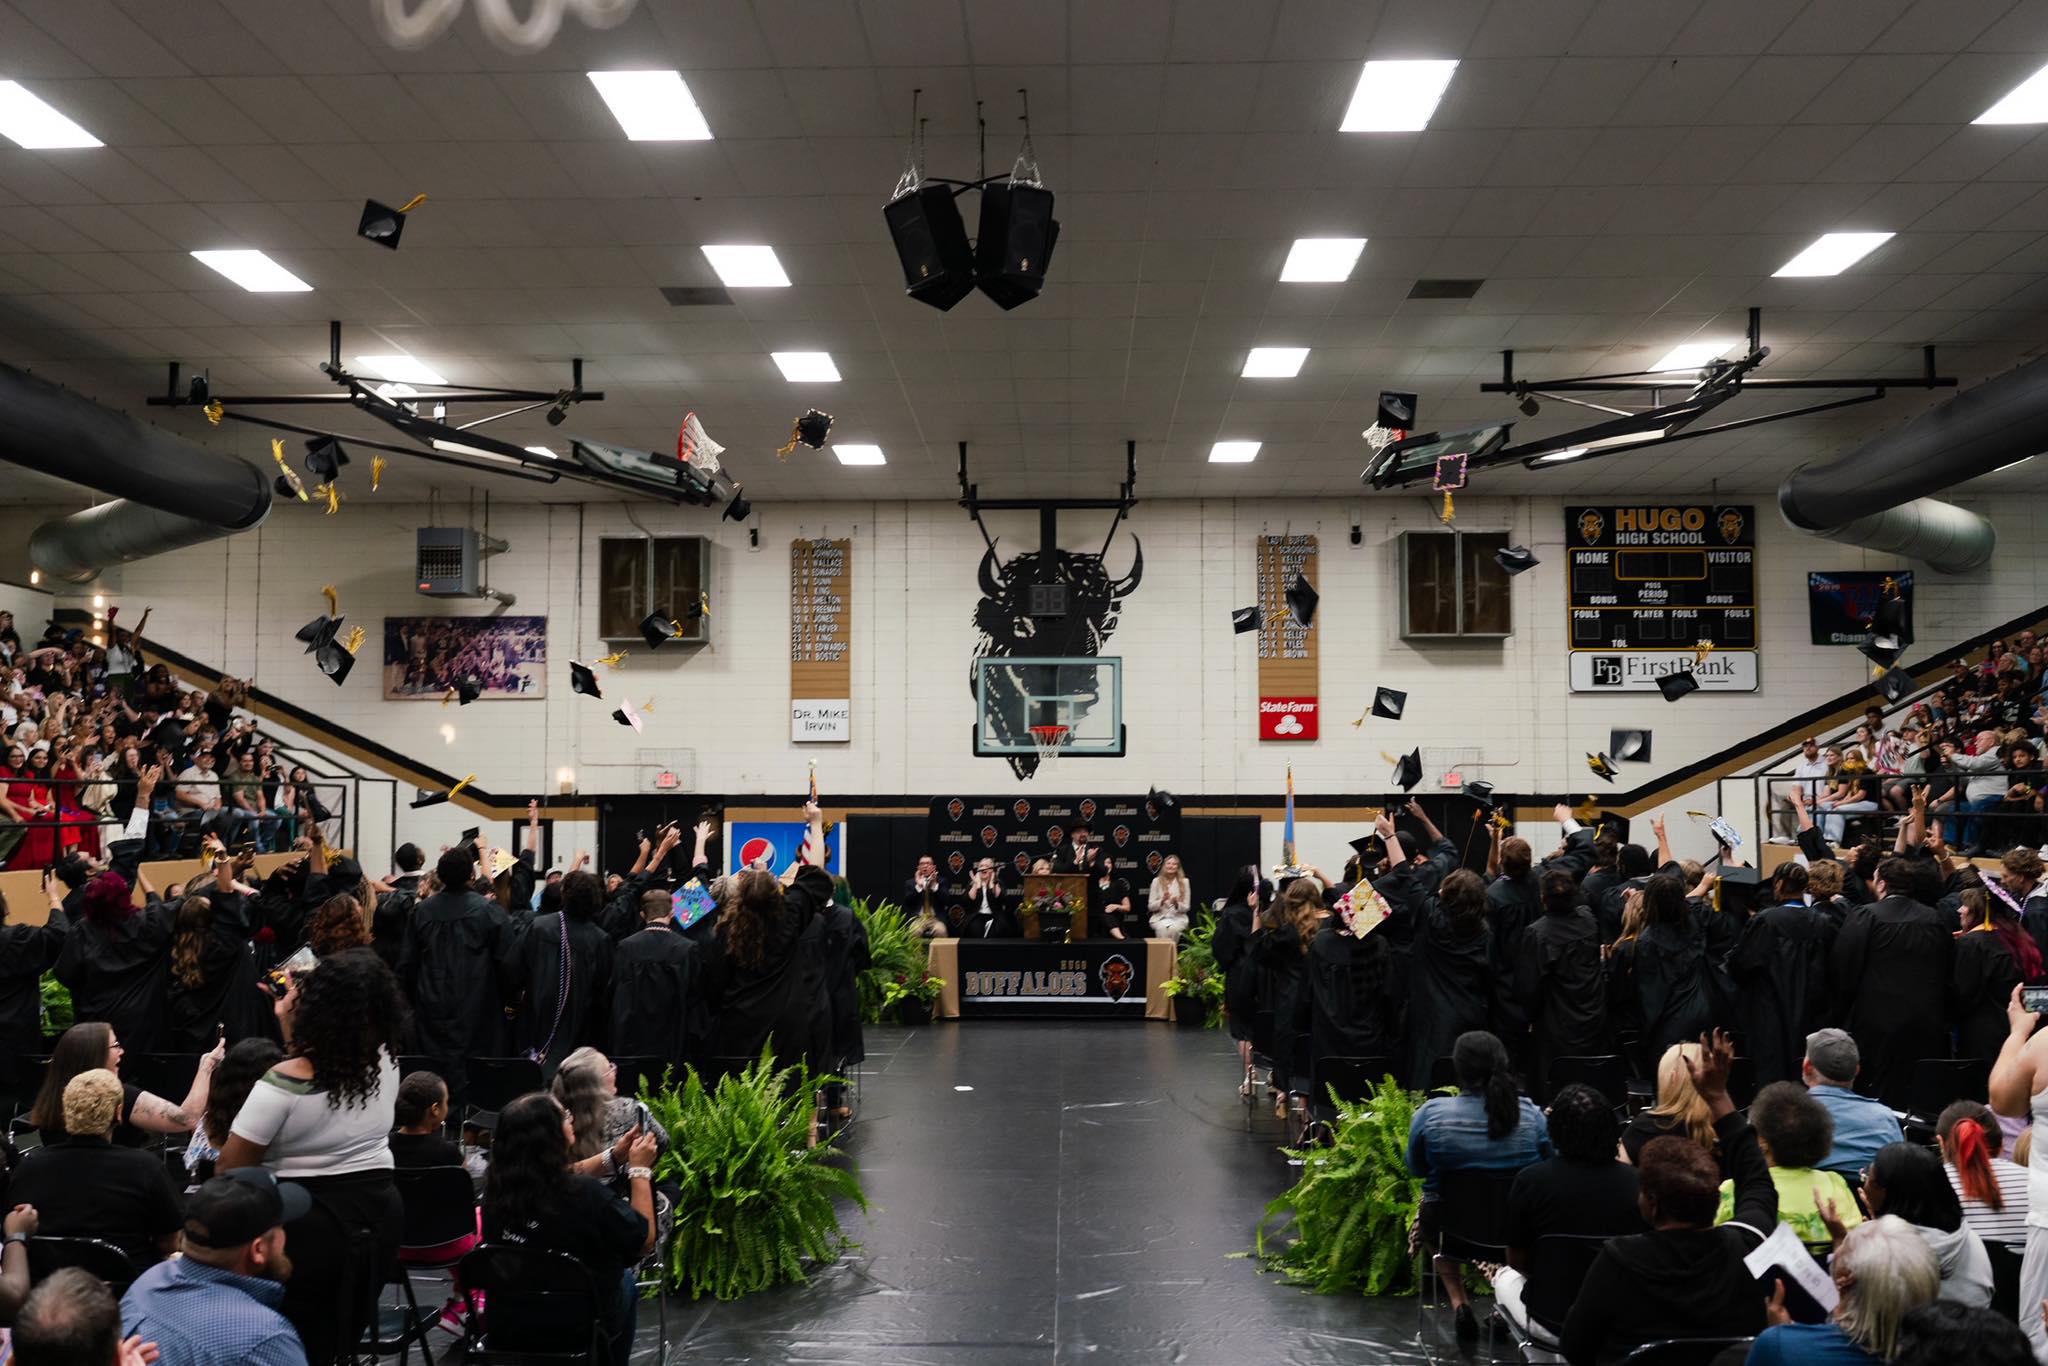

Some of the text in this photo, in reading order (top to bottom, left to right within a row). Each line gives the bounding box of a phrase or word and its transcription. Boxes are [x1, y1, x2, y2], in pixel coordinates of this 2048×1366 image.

[1615, 508, 1706, 531] HUGO
[1616, 532, 1706, 544] HIGH SCHOOL
[812, 548, 843, 558] JOHNSON
[1707, 552, 1751, 563] VISITOR
[1282, 555, 1306, 564] KELLEY
[1576, 552, 1609, 564] HOME
[813, 559, 843, 567] WALLACE
[792, 568, 799, 576] 2
[812, 568, 842, 576] EDWARDS
[814, 586, 832, 594] KING
[1638, 590, 1668, 598] PERIOD
[812, 596, 841, 604] SHELTON
[1590, 596, 1617, 604] BONUS
[1706, 596, 1734, 604] BONUS
[812, 605, 841, 613] FREEMAN
[813, 614, 834, 622] JONES
[1574, 610, 1600, 619] FOULS
[1633, 610, 1698, 619] PLAYER FOULS
[1724, 610, 1750, 618] FOULS
[816, 634, 832, 642] KING
[1283, 631, 1308, 639] KELLEY
[815, 642, 848, 651] EDWARDS
[1611, 639, 1628, 648] TOL
[1627, 656, 1737, 676] FirstBank
[1594, 659, 1621, 684] FB
[818, 709, 848, 719] MIKE
[804, 720, 836, 731] IRVIN
[1060, 960, 1087, 970] HUGO
[965, 971, 1087, 996] BUFFALOES
